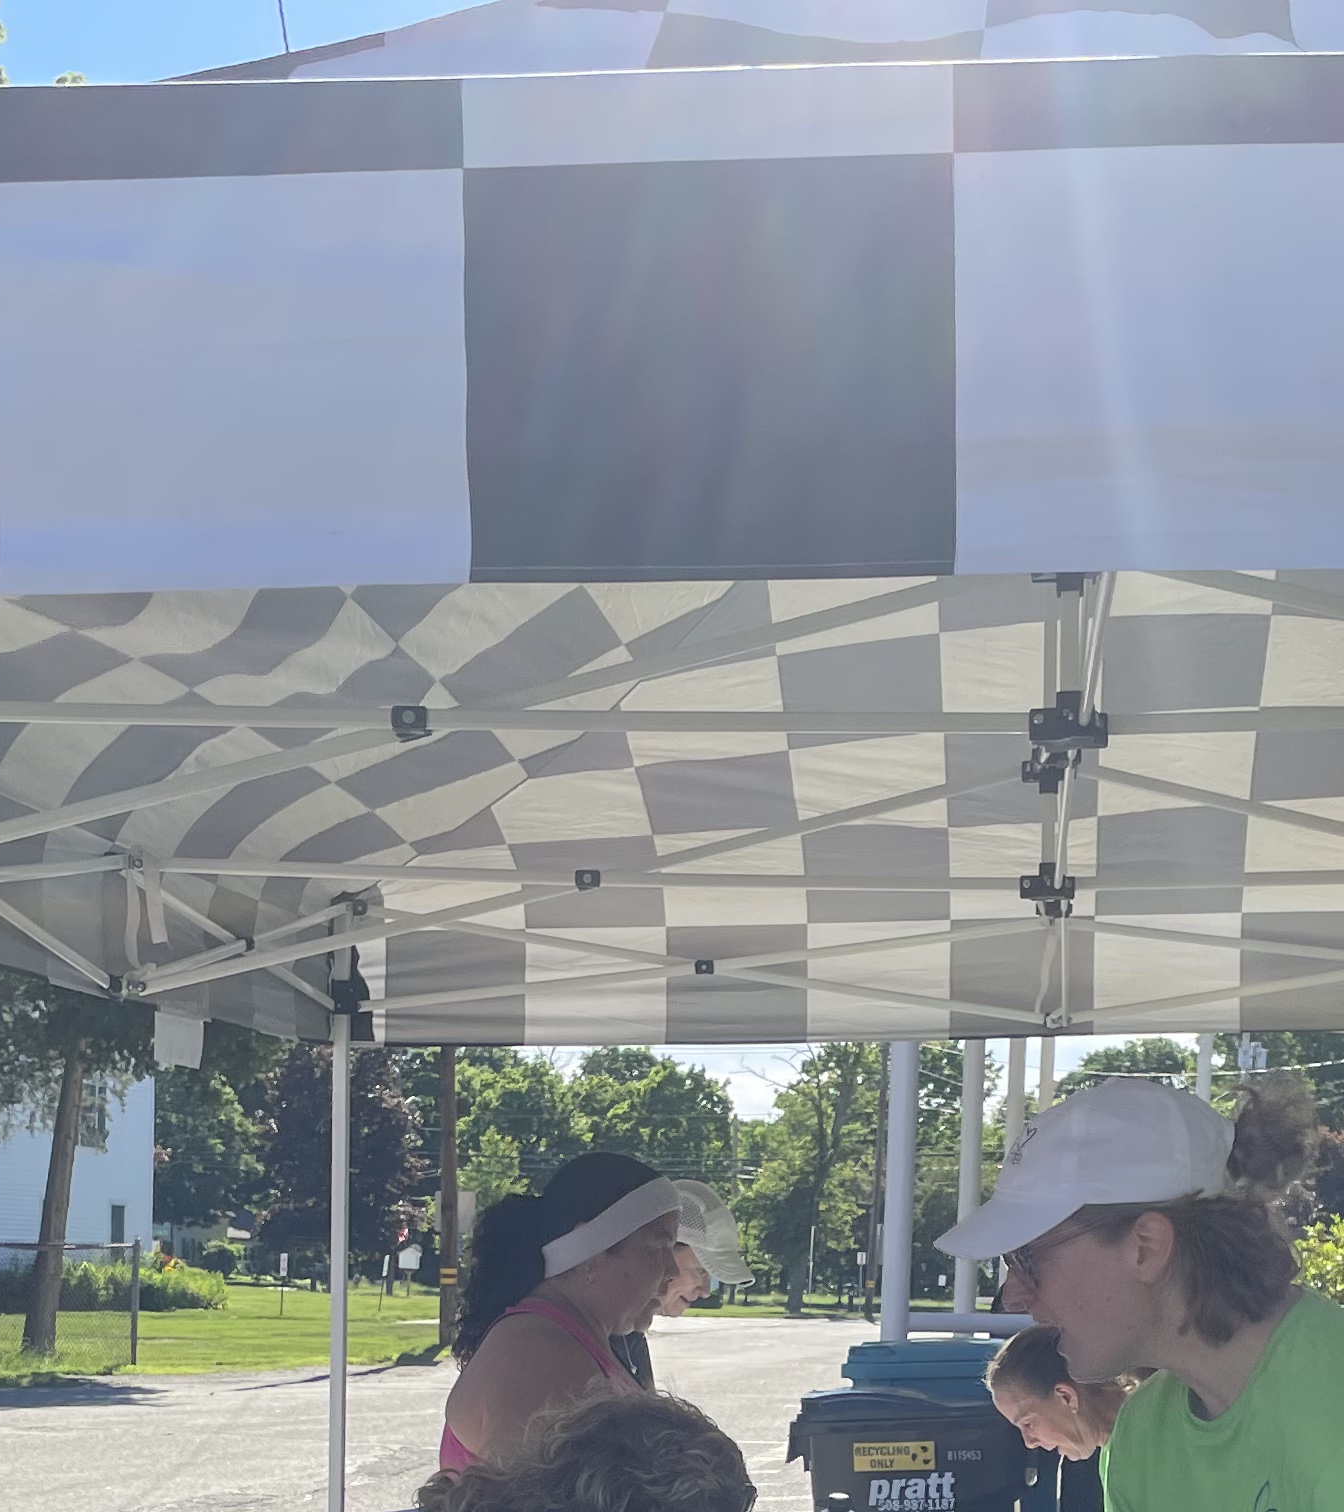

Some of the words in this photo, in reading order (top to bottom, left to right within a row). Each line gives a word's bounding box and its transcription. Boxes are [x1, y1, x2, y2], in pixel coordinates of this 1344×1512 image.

[854, 1445, 911, 1457] RECYCLING
[869, 1458, 895, 1469] ONLY
[868, 1471, 956, 1507] pratt
